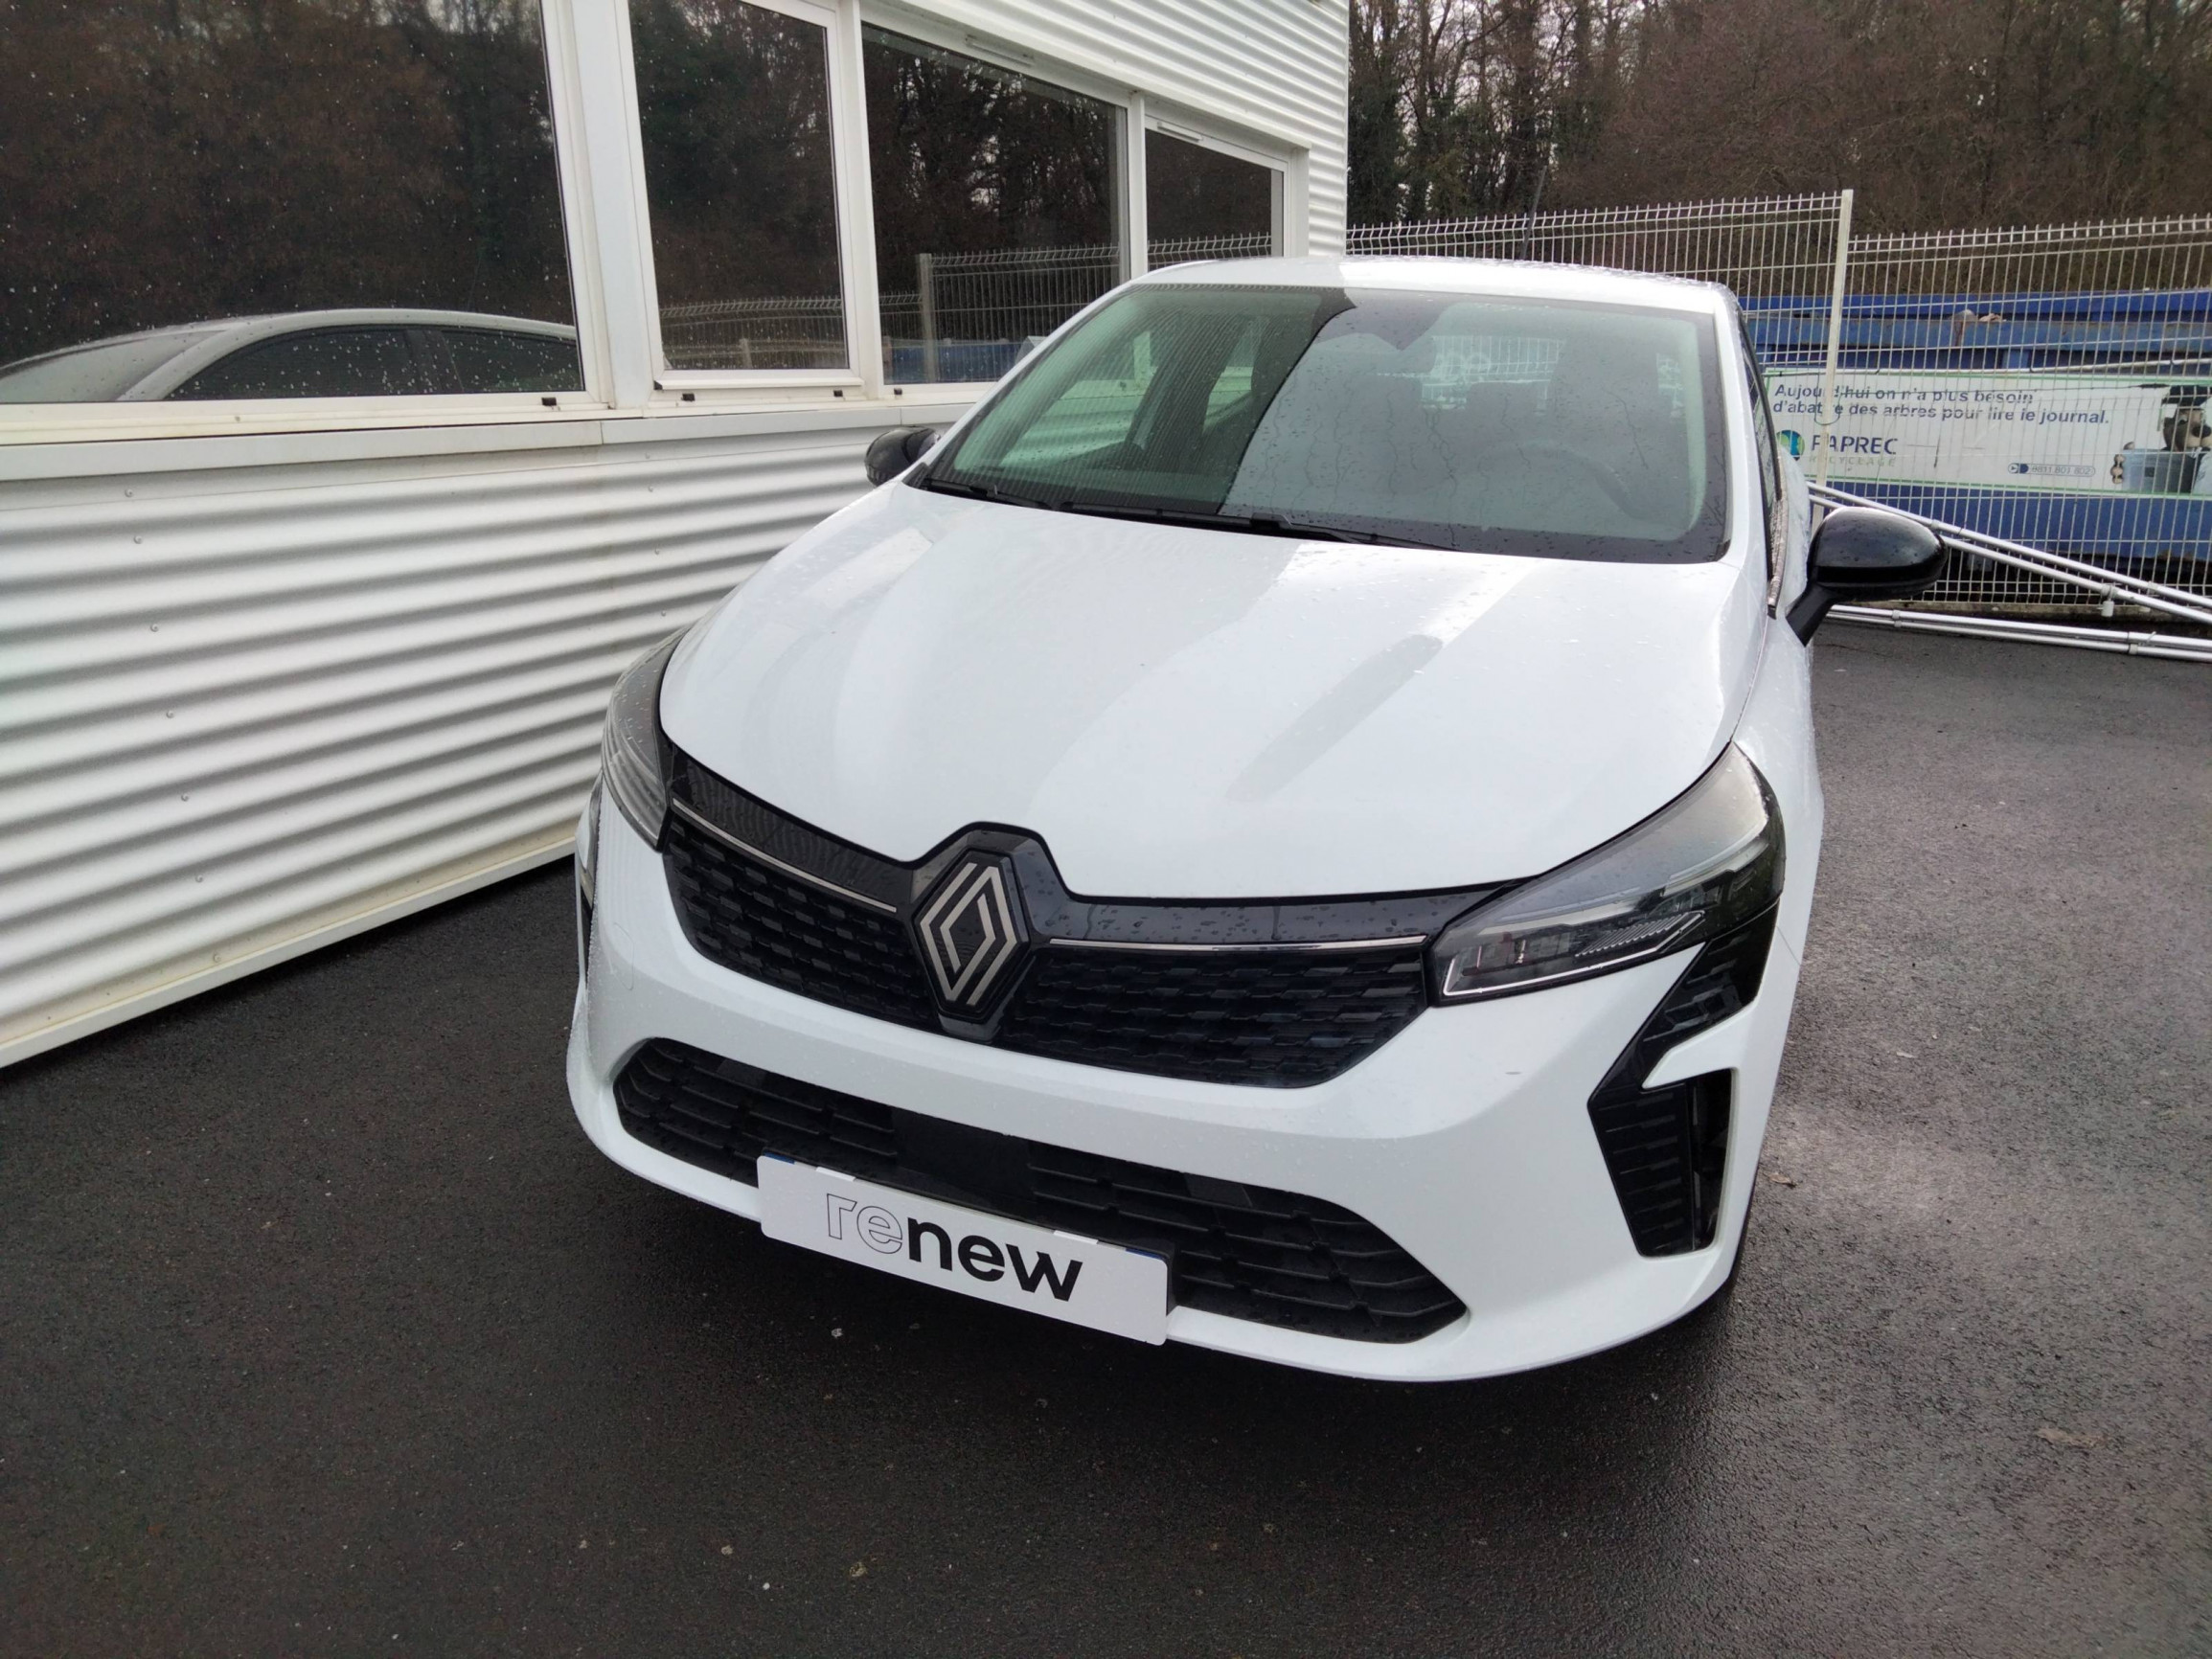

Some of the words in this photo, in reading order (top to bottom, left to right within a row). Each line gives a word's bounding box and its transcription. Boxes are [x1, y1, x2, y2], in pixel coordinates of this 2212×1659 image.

[1875, 389, 1896, 399] on
[1901, 387, 1927, 400] n'a
[1932, 389, 1968, 402] plus
[1974, 390, 2033, 403] besoin
[1773, 400, 1843, 414] d'abate
[1849, 403, 1878, 415] des
[1883, 404, 1937, 418] arbres
[1941, 408, 1983, 421] pour
[1987, 406, 2014, 420] lire
[2020, 408, 2036, 420] le
[2039, 408, 2109, 424] journal.
[826, 1193, 1083, 1302] renew
